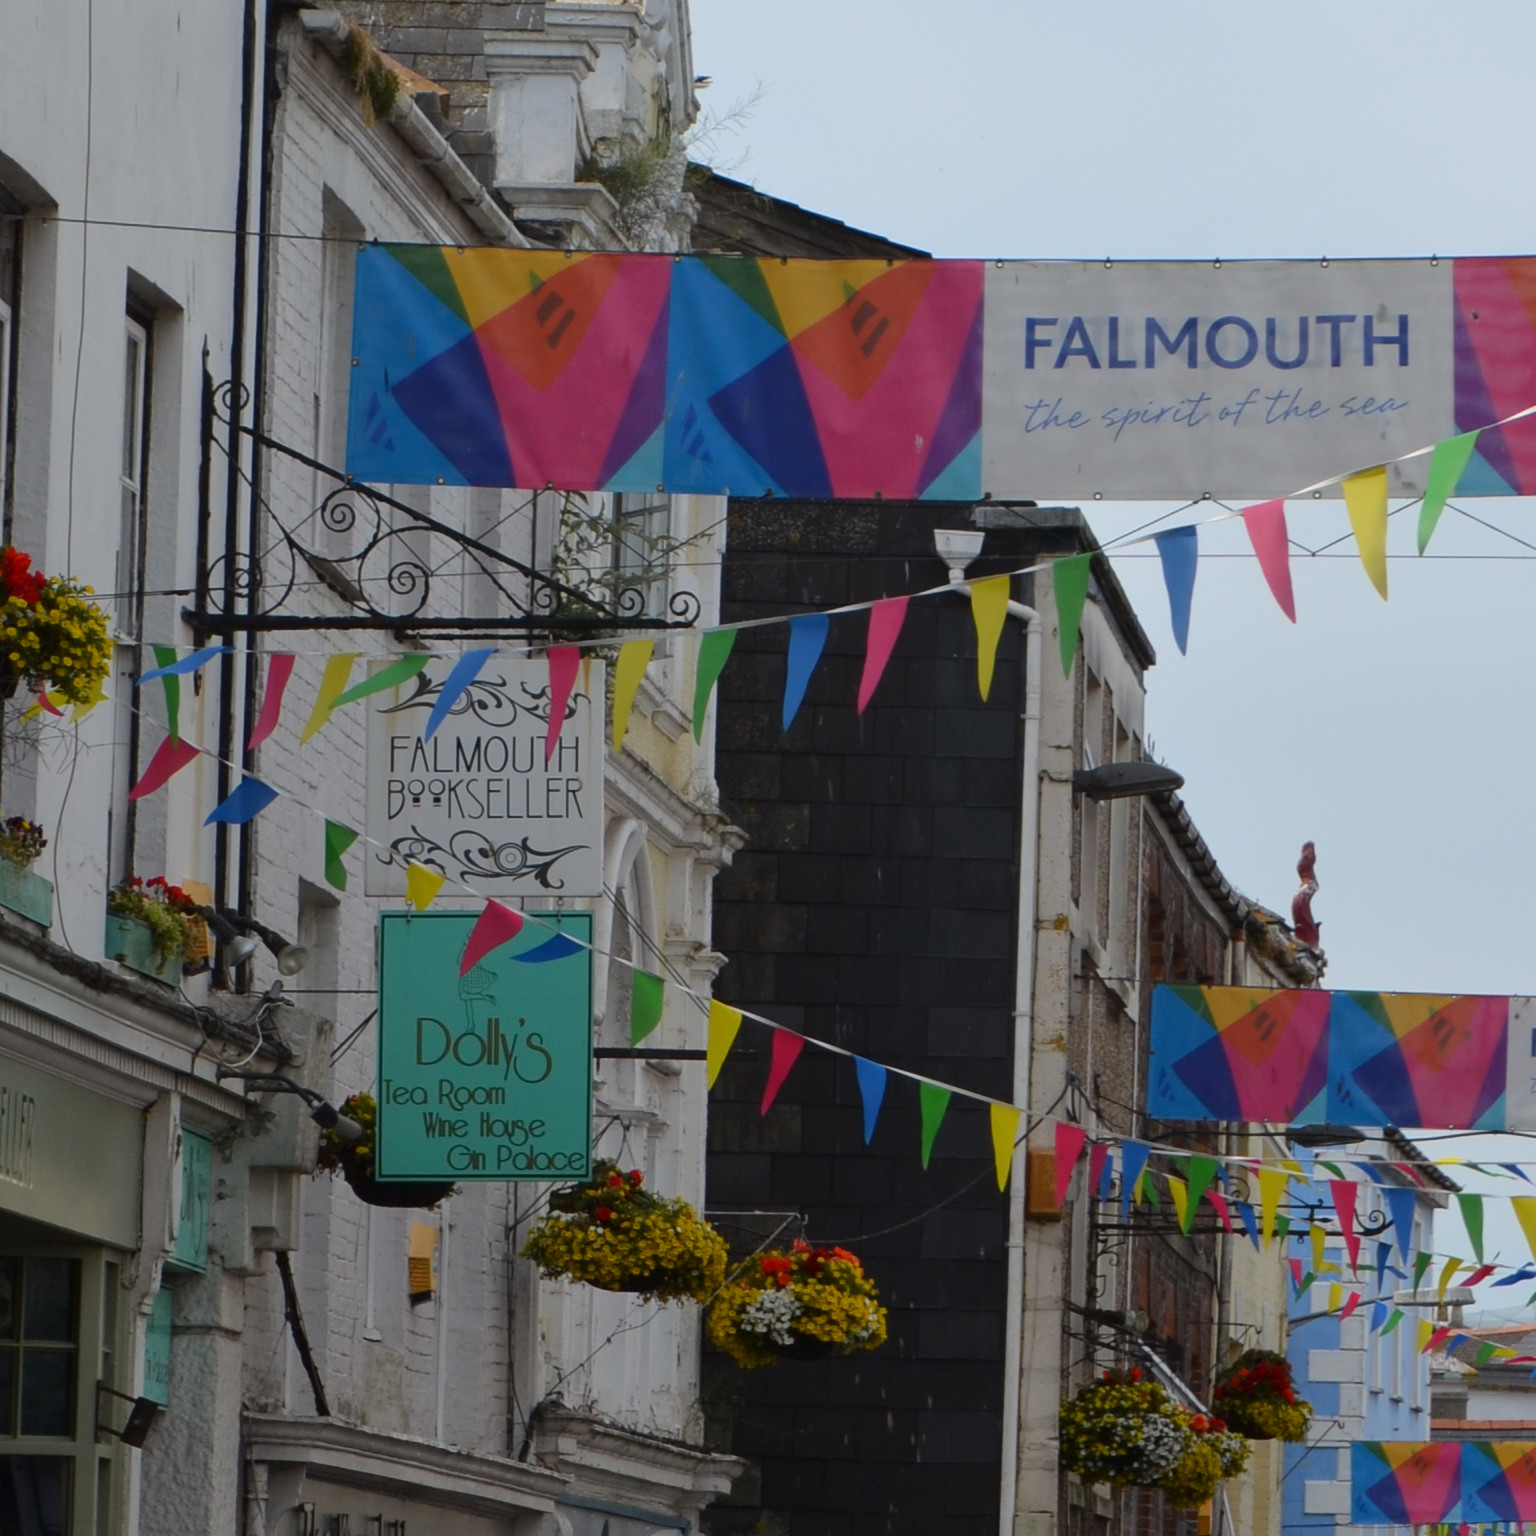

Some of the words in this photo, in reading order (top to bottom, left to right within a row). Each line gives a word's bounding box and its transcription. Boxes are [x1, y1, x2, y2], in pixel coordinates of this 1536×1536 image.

[1024, 315, 1409, 370] FALMOUTH
[1024, 398, 1090, 434] the
[1101, 392, 1211, 442] spirit
[1218, 388, 1260, 426] of
[1265, 387, 1331, 429] the
[1340, 395, 1409, 417] sea
[390, 735, 579, 773] FALMOUTH
[388, 778, 583, 820] BOOKSELLER
[416, 1017, 552, 1084] Dolly's
[383, 1079, 428, 1105] Tea
[438, 1078, 506, 1112] Room
[422, 1112, 470, 1139] Wine
[480, 1112, 547, 1147] House
[446, 1144, 486, 1171] Gin
[496, 1144, 586, 1171] Palace
